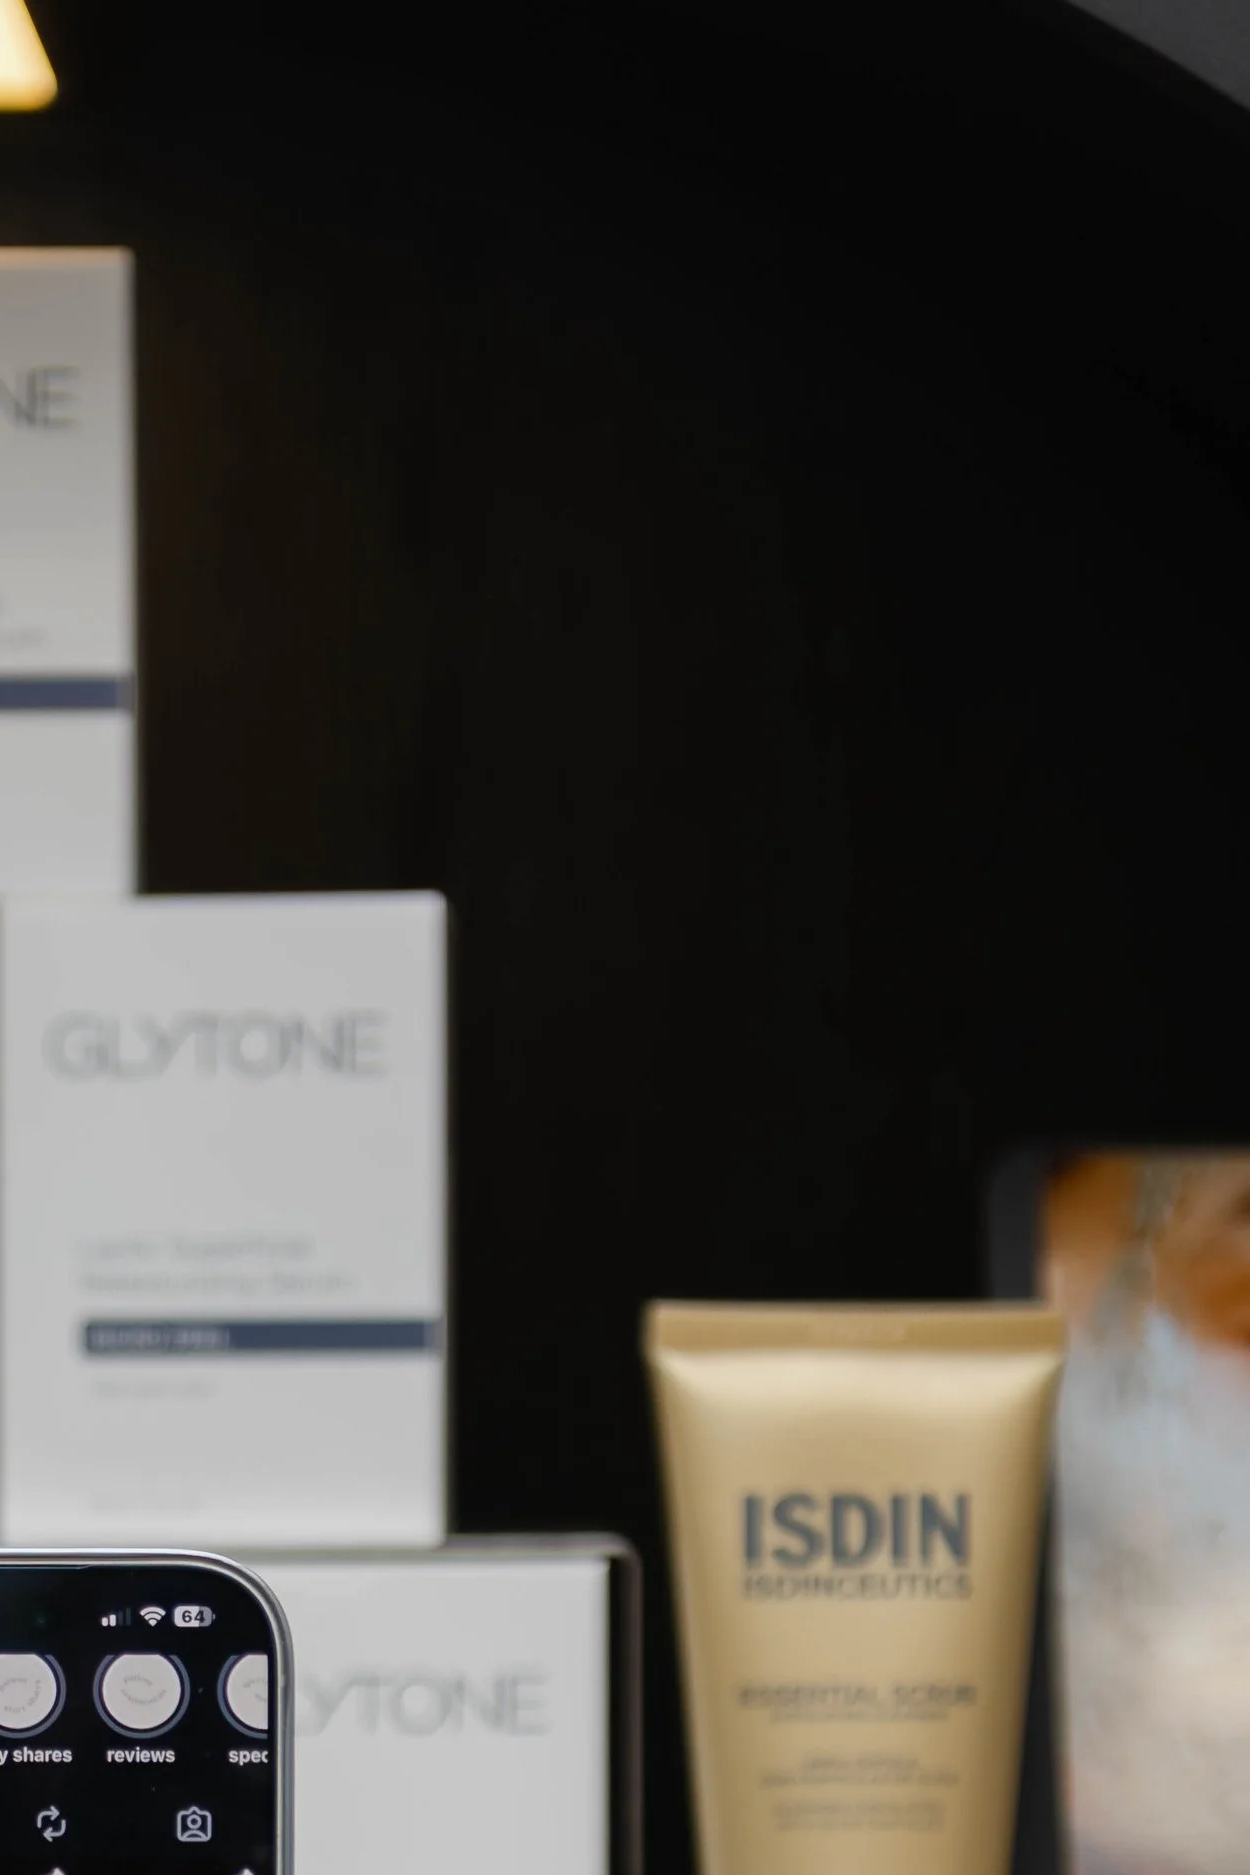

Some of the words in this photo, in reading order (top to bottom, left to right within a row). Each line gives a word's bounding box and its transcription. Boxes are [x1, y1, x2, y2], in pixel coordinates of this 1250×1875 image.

[43, 1009, 390, 1082] GLYTONE
[743, 1492, 973, 1570] ISDIN
[181, 1609, 206, 1624] 64
[12, 1746, 73, 1763] shares
[106, 1747, 176, 1763] reviews
